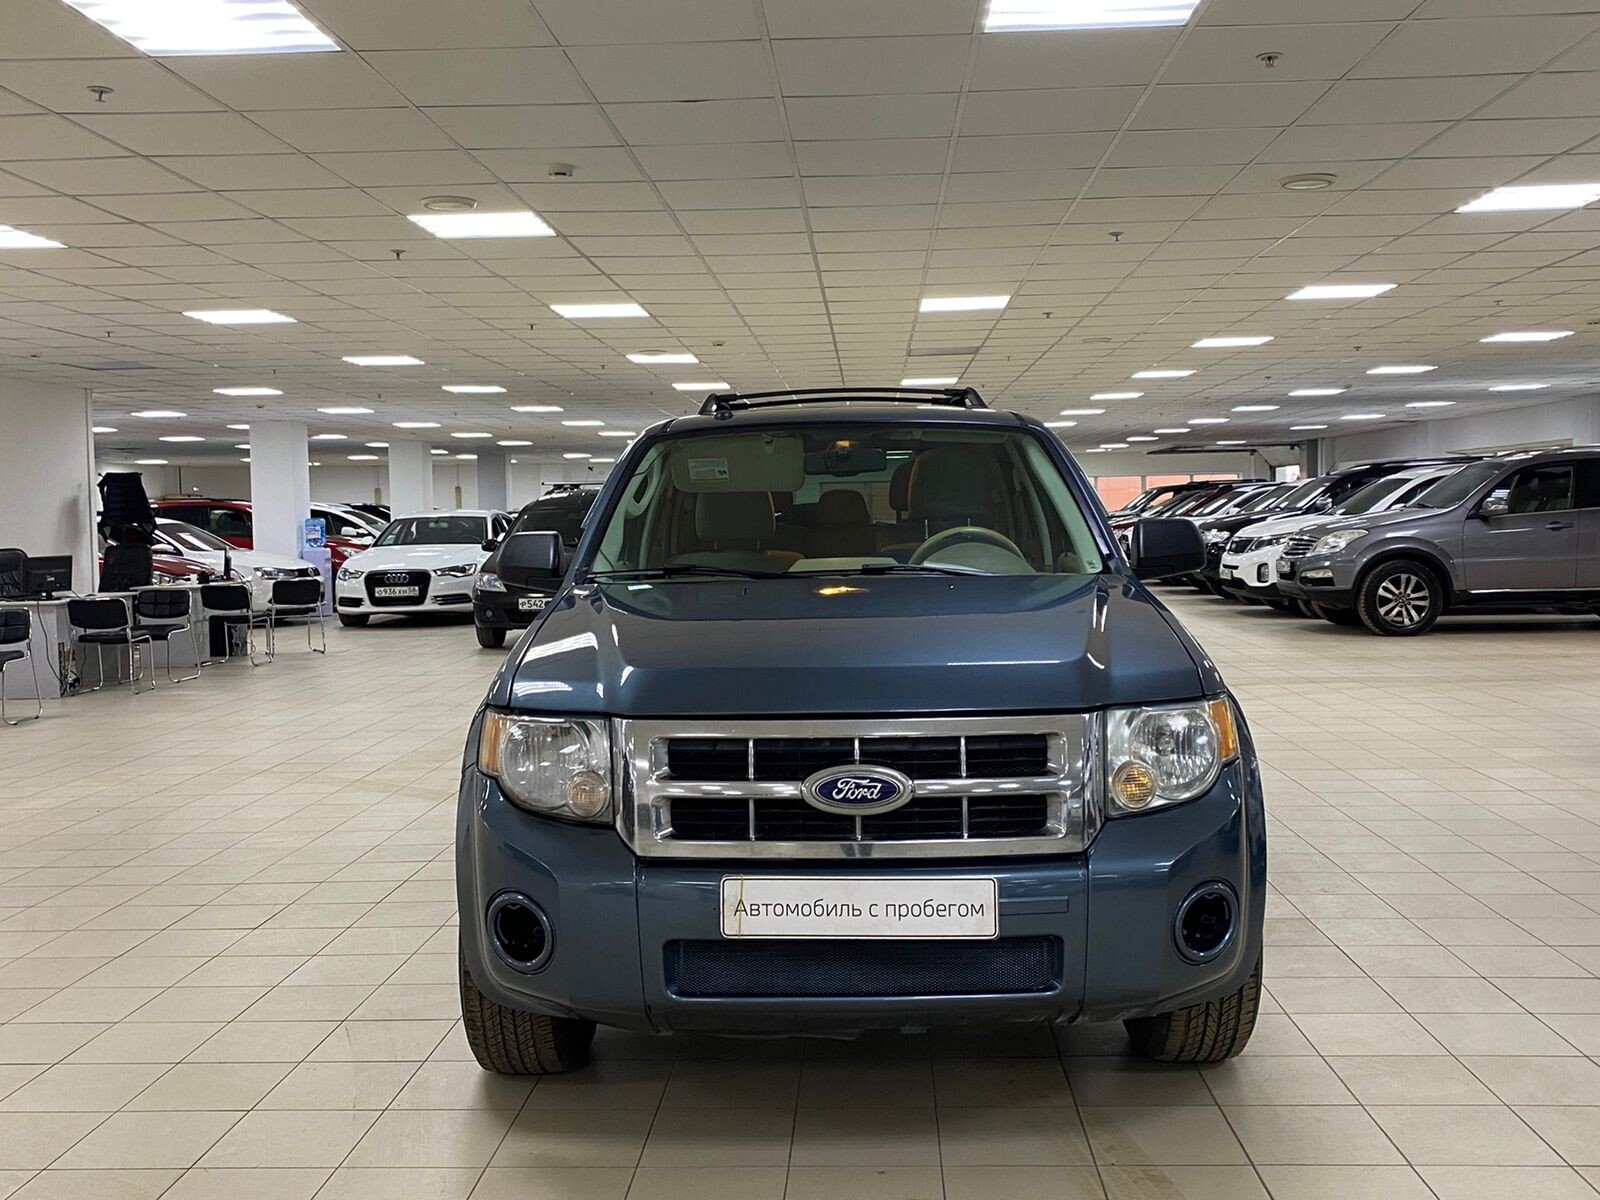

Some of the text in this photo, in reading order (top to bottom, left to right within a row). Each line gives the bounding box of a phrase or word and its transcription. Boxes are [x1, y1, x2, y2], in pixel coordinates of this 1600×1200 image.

[832, 778, 882, 799] Ford
[734, 899, 985, 921] Автомобиль с пробегом
